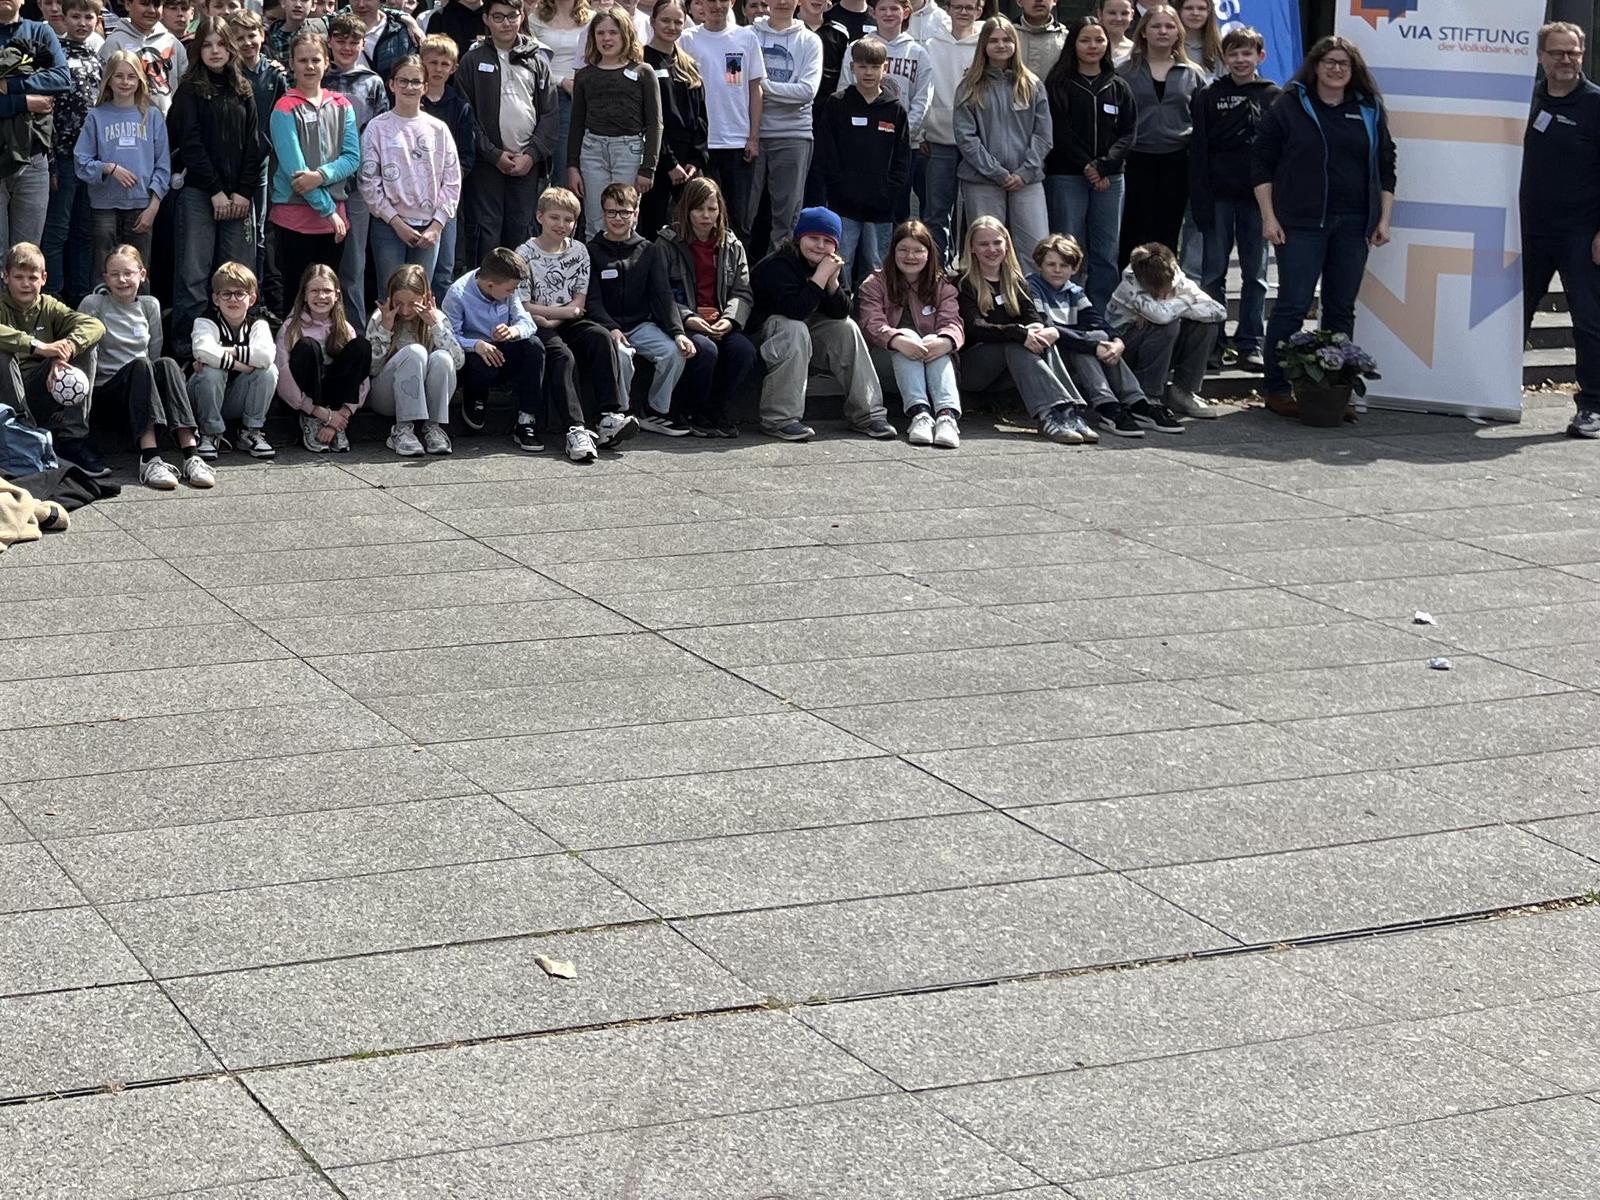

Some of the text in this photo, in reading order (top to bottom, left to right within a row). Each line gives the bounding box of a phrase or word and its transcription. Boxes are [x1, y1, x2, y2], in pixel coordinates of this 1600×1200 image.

[1398, 24, 1530, 45] VIA STIFTUNG
[1438, 42, 1456, 51] der
[1458, 42, 1512, 55] Volksbank
